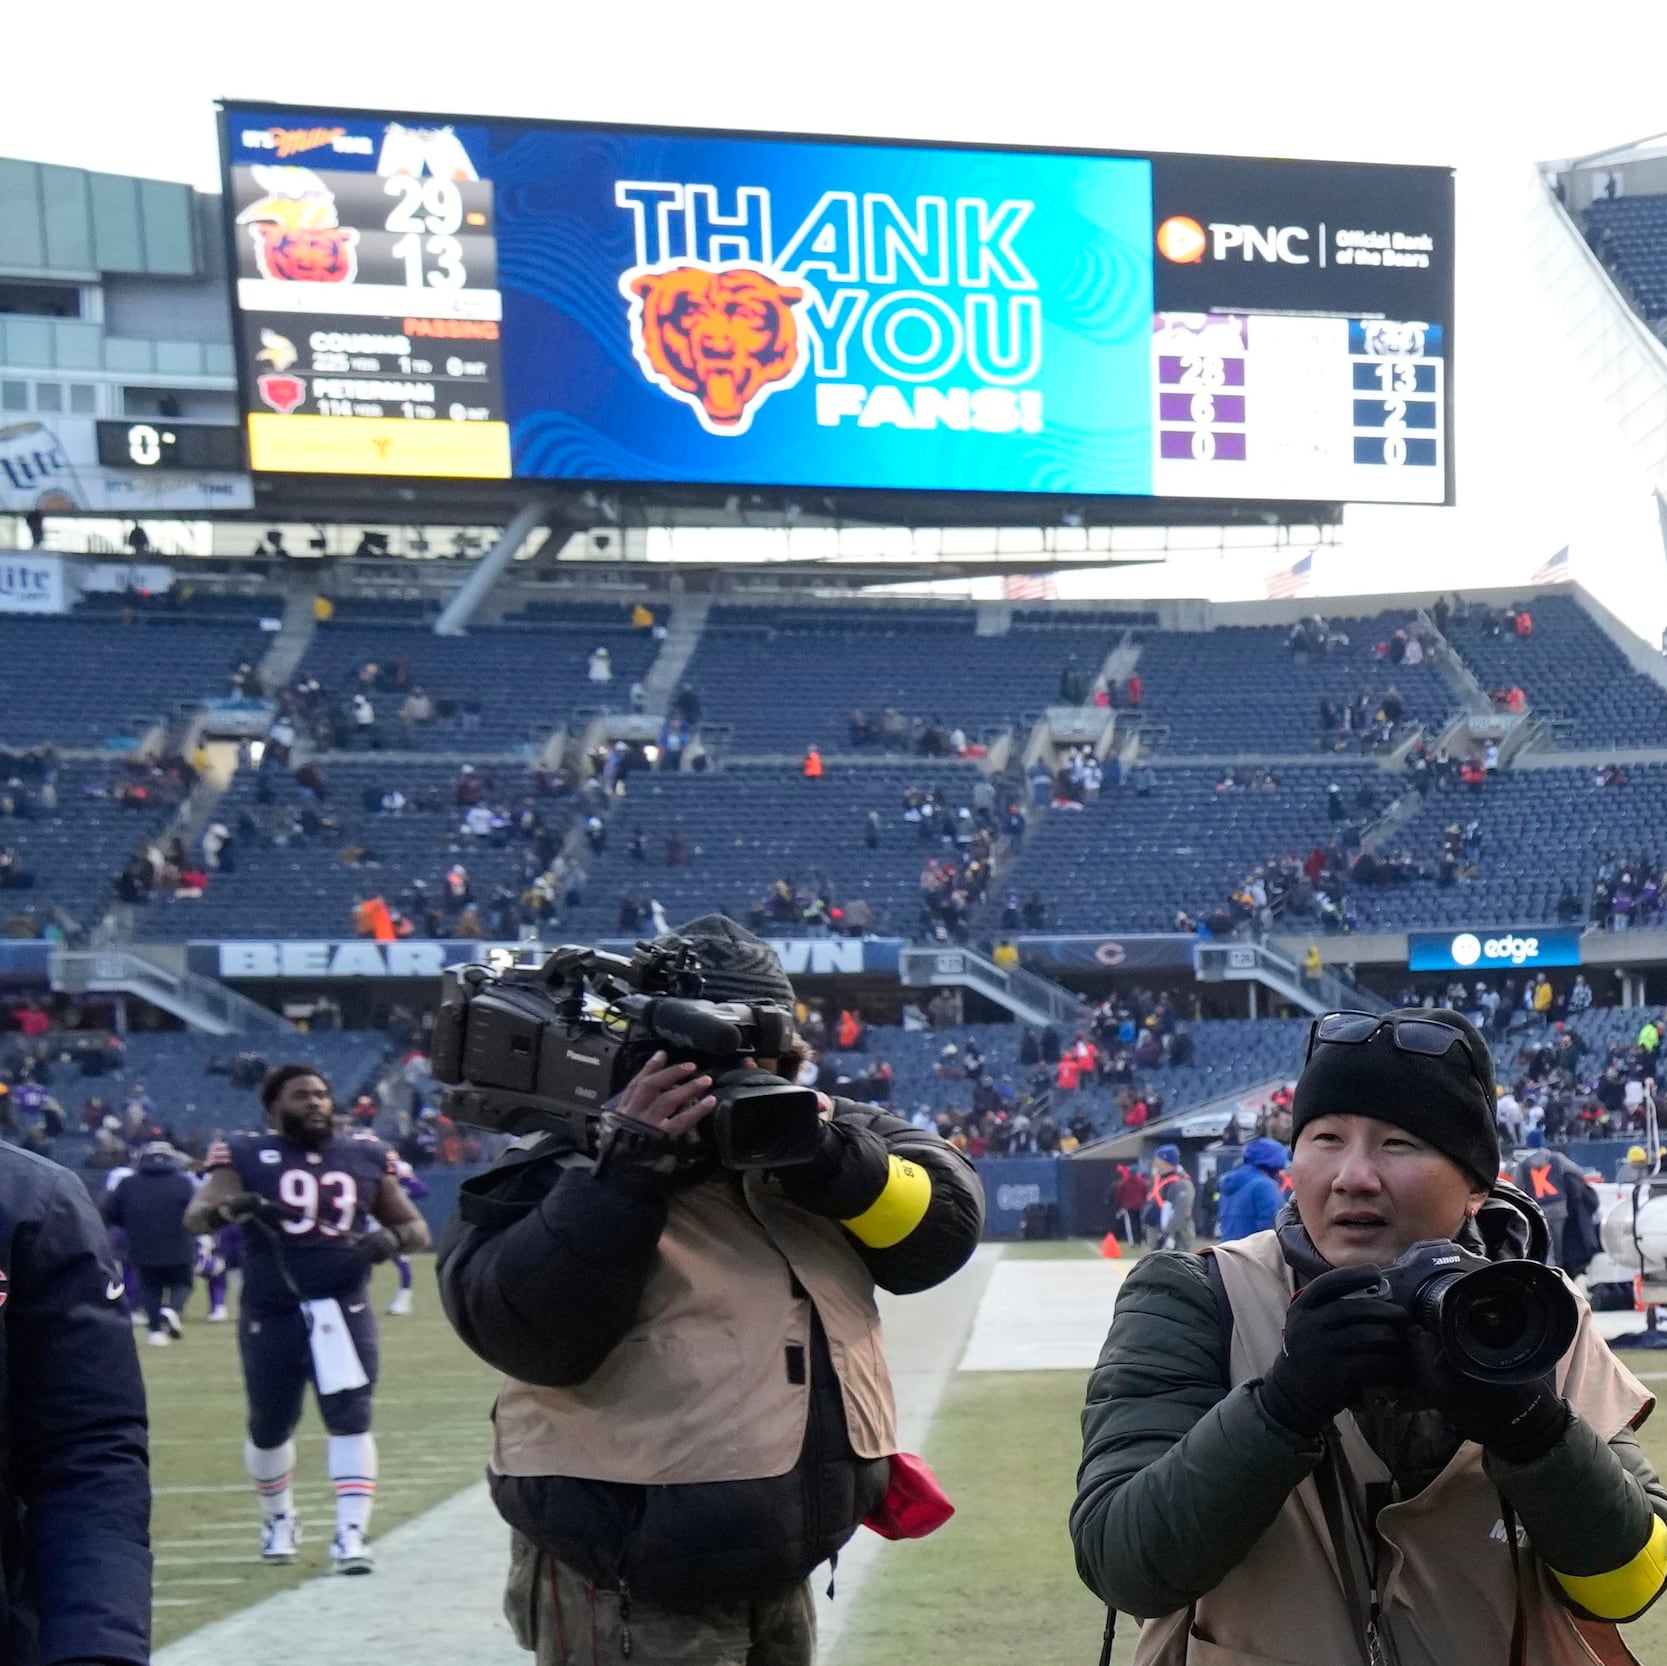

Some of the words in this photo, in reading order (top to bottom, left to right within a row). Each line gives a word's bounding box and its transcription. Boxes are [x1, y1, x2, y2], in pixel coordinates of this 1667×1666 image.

[384, 174, 463, 235] 29
[615, 180, 1039, 290] THANK
[1208, 223, 1310, 264] PNC
[1336, 229, 1391, 248] Official
[1392, 231, 1433, 250] Bank
[392, 233, 467, 288] 13
[1336, 247, 1354, 264] of
[1354, 248, 1381, 265] the
[1382, 249, 1429, 268] Bears
[309, 331, 411, 355] COUSINS
[403, 317, 499, 340] PASSING
[806, 289, 1043, 386] YOU
[398, 356, 411, 374] 1
[446, 355, 464, 376] 0
[1179, 356, 1226, 387] 28
[1375, 362, 1417, 393] 13
[312, 378, 435, 402] PETERMAN
[401, 401, 415, 419] 1
[449, 402, 466, 421] 0
[816, 383, 1045, 434] FANS!
[1190, 393, 1216, 423] 6
[1383, 399, 1407, 429] 2
[1191, 430, 1216, 461] 0
[1383, 437, 1407, 467] 0
[218, 942, 445, 977] BEAR
[1483, 936, 1540, 960] edge
[566, 1049, 601, 1066] Panasonic
[1530, 1164, 1559, 1199] K
[280, 1168, 357, 1237] 93
